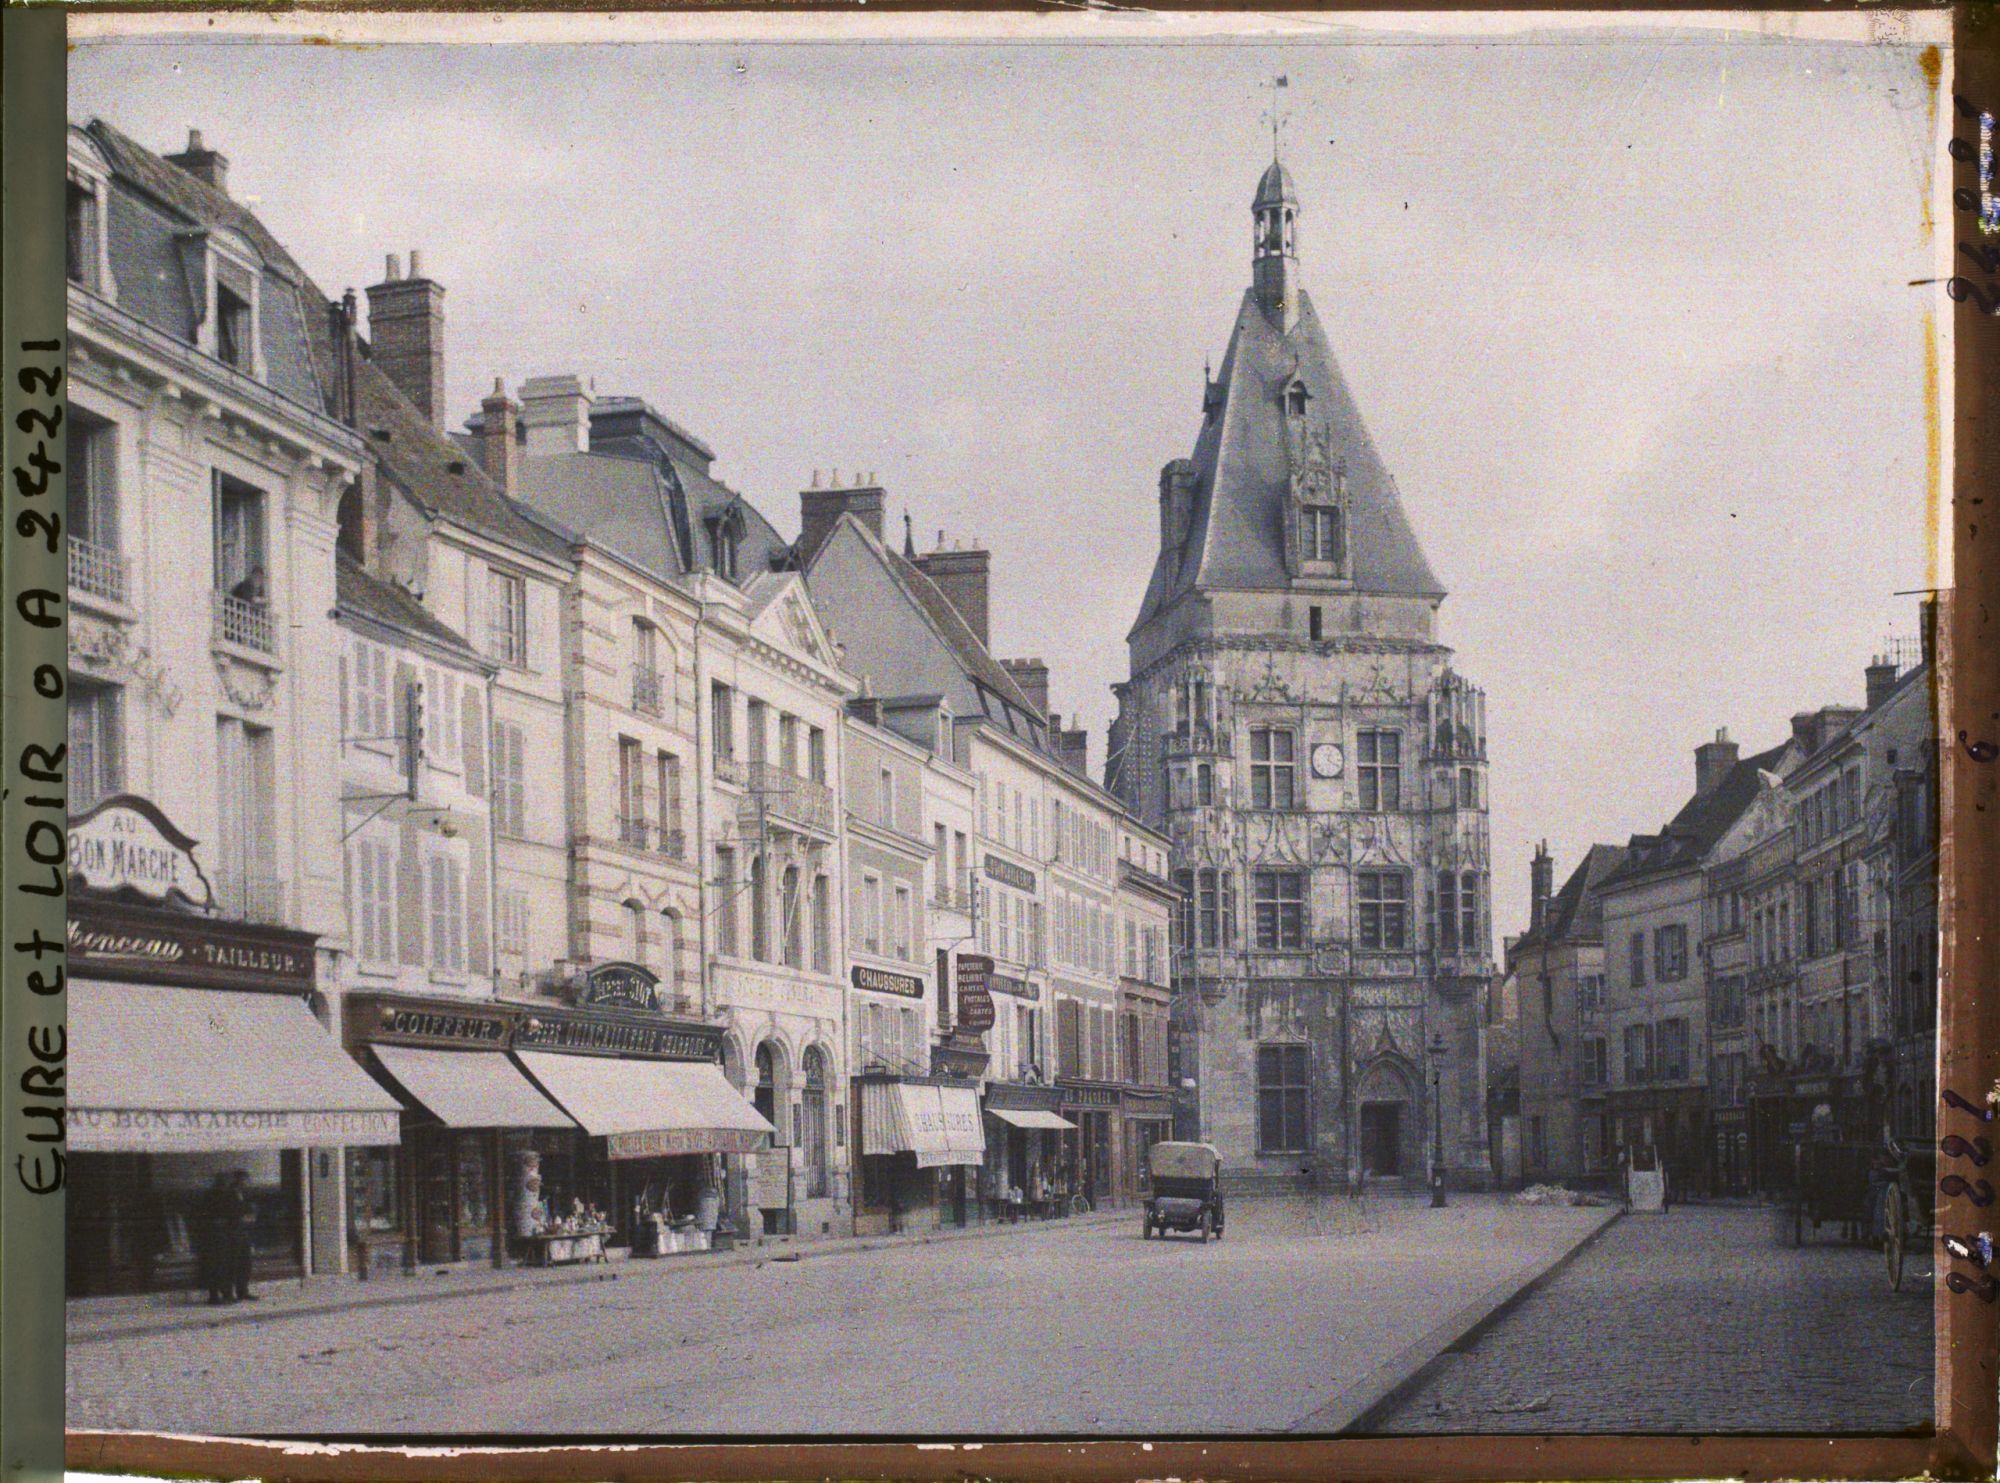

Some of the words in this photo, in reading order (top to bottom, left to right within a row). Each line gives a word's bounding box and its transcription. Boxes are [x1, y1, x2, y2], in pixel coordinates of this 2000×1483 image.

[12, 339, 62, 554] 24221
[16, 588, 61, 629] A
[18, 744, 66, 898] LOIR
[112, 815, 136, 833] AU
[69, 833, 105, 870] BON
[14, 929, 65, 996] et
[205, 943, 295, 973] TAILLEUR
[859, 968, 916, 995] CHAUSSURES
[394, 1012, 493, 1040] COIFFEUR
[15, 1025, 66, 1196] EURE
[115, 1110, 171, 1129] BON
[178, 1110, 288, 1130] MARCHE
